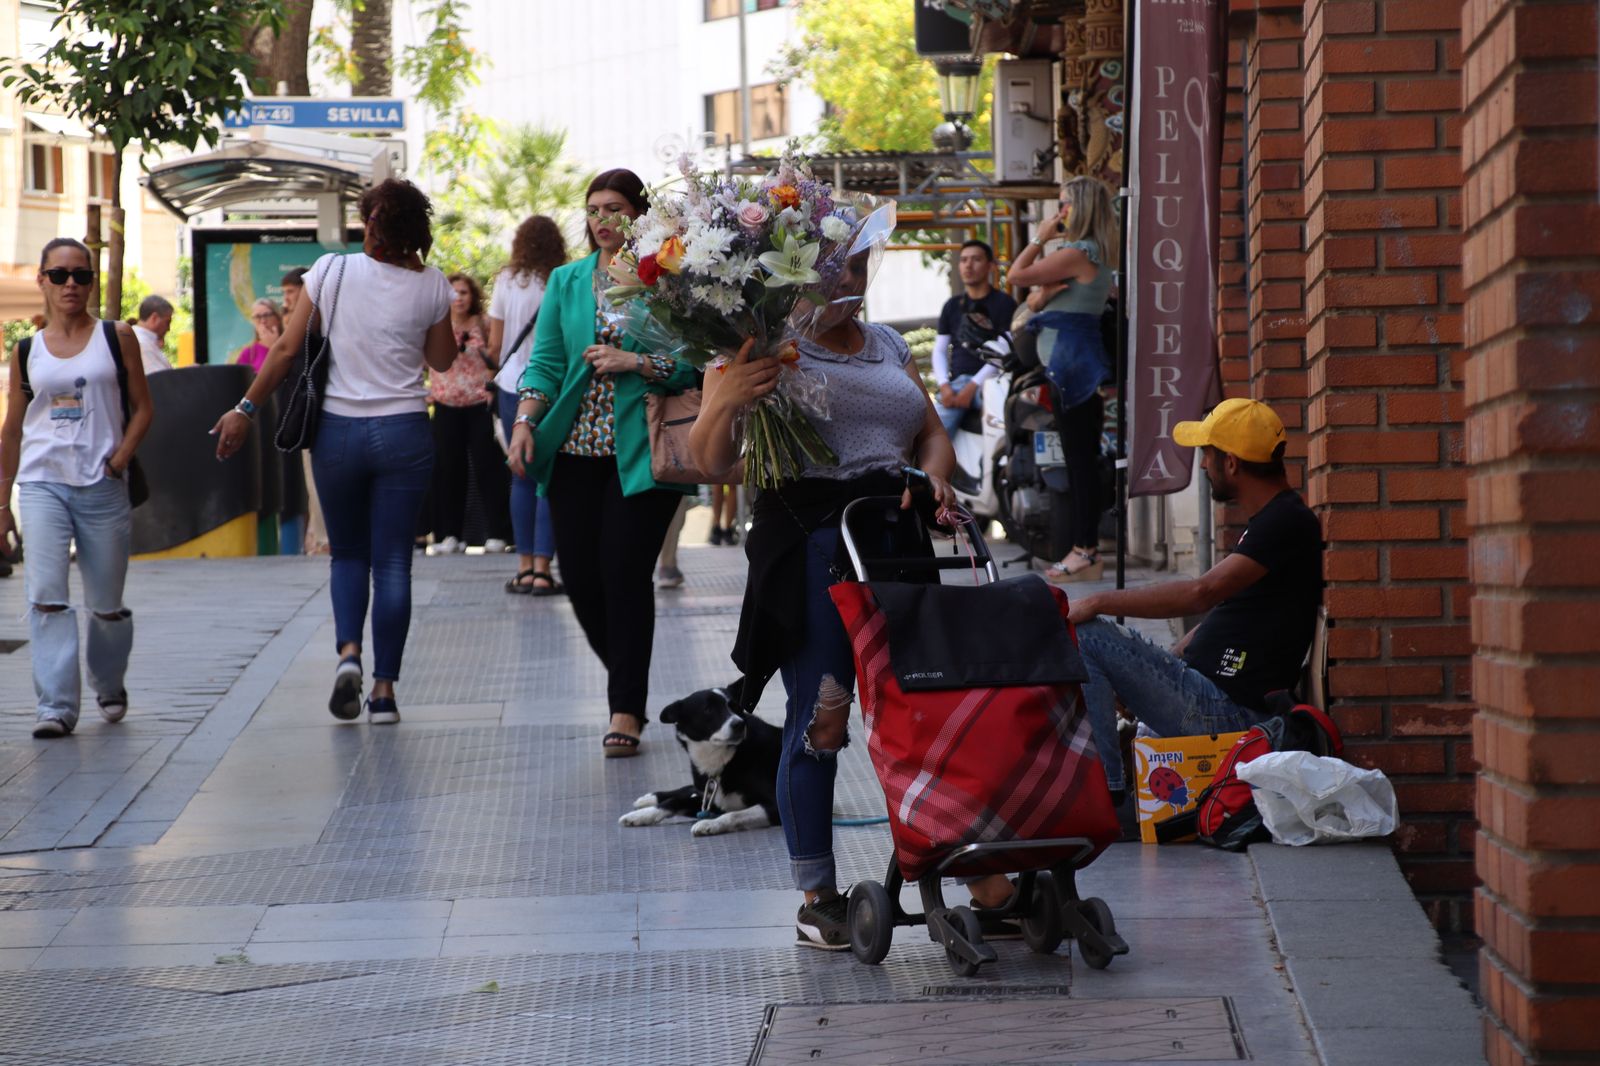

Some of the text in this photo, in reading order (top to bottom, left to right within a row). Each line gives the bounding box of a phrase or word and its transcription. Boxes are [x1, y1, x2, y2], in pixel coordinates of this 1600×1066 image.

[256, 107, 400, 122] A-49 SEVILLA
[1141, 66, 1184, 480] PELUQUERÍA
[1148, 751, 1183, 763] Natur
